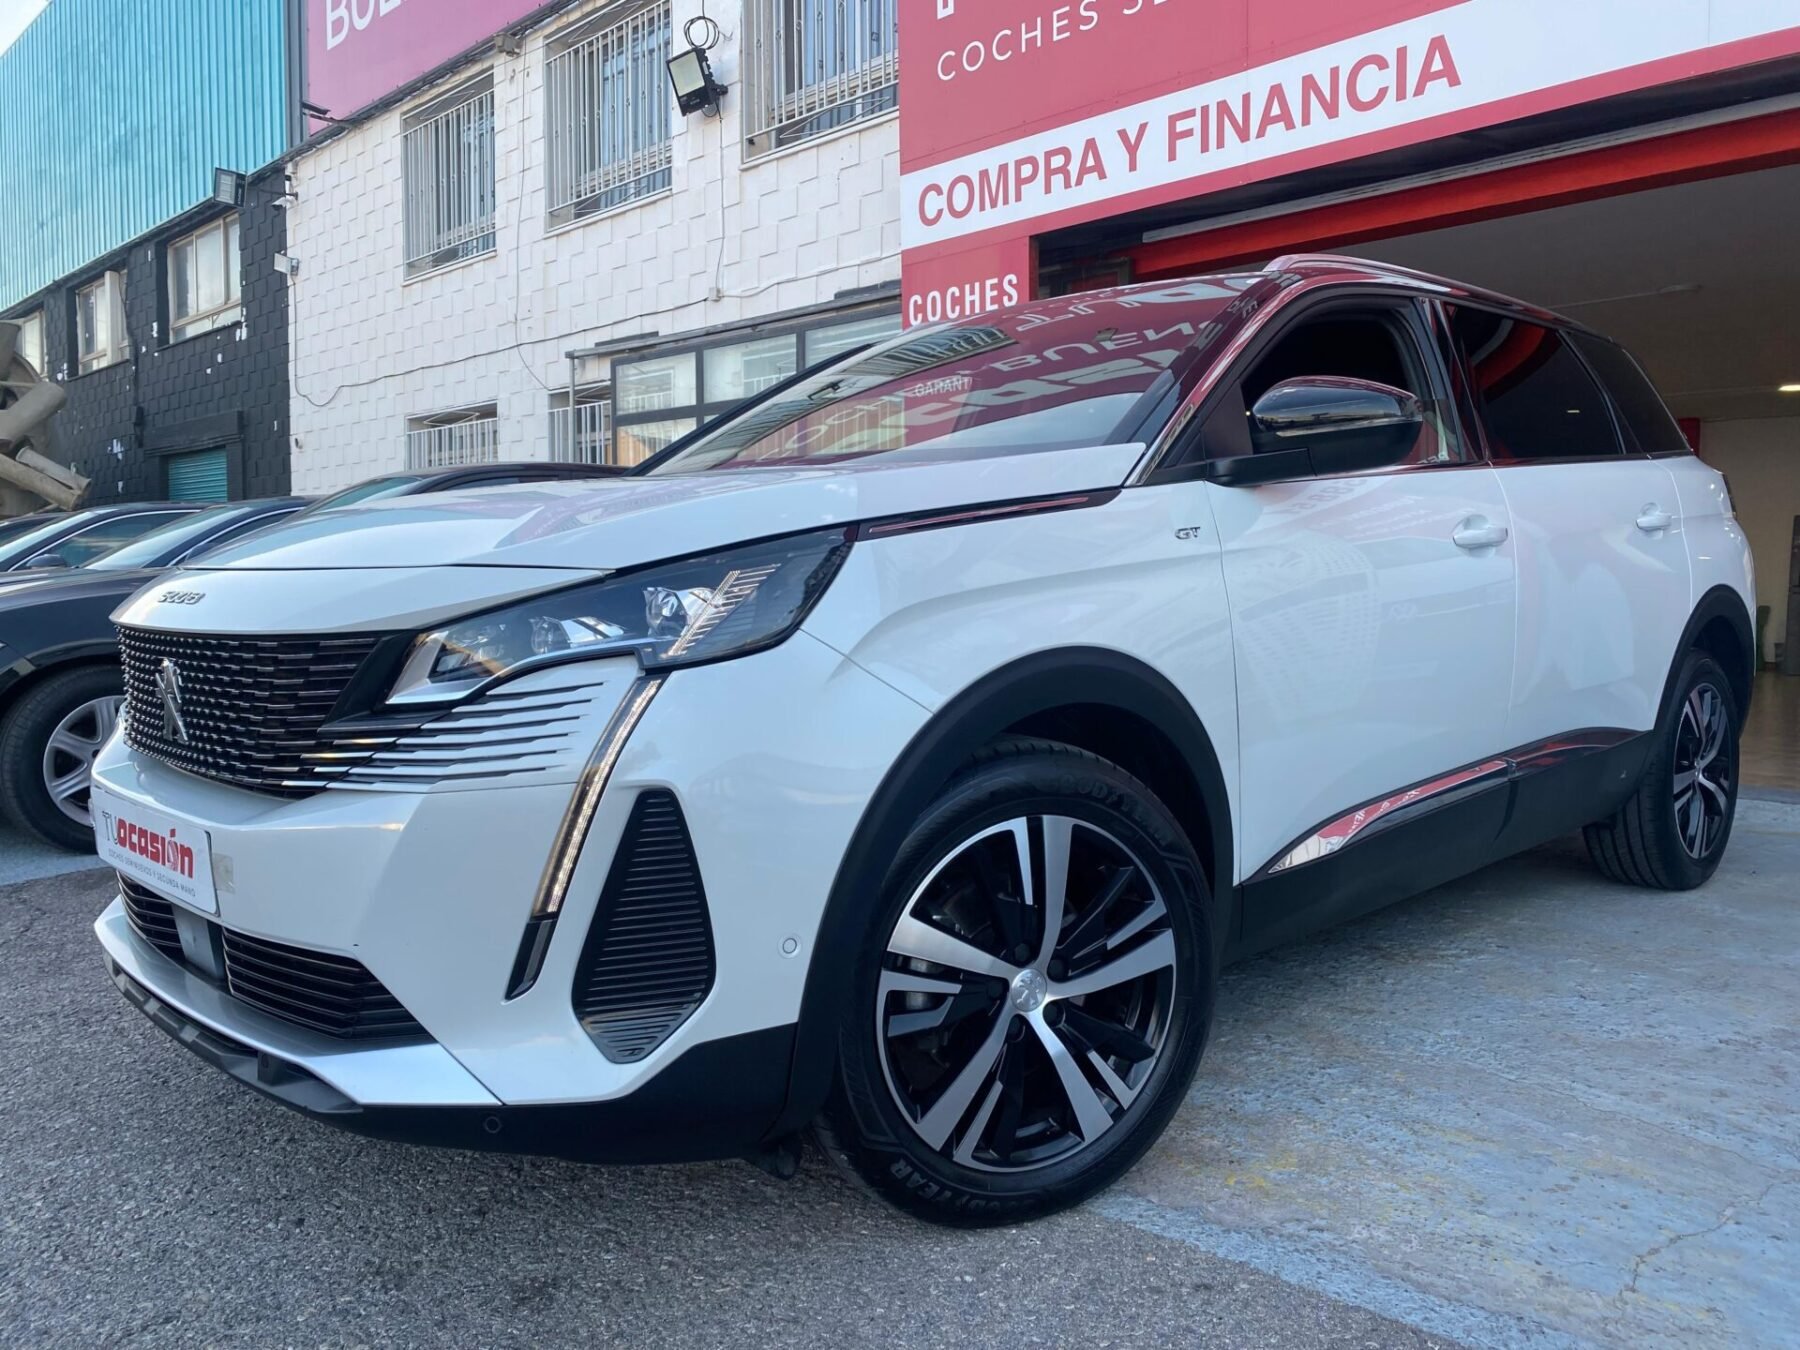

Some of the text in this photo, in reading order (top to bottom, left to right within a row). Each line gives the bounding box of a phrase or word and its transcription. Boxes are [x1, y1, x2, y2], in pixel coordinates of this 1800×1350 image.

[937, 0, 1098, 81] COCHES
[918, 34, 1462, 227] COMPRA Y FINANCIA
[908, 273, 1018, 327] COCHES
[1174, 526, 1201, 540] GT
